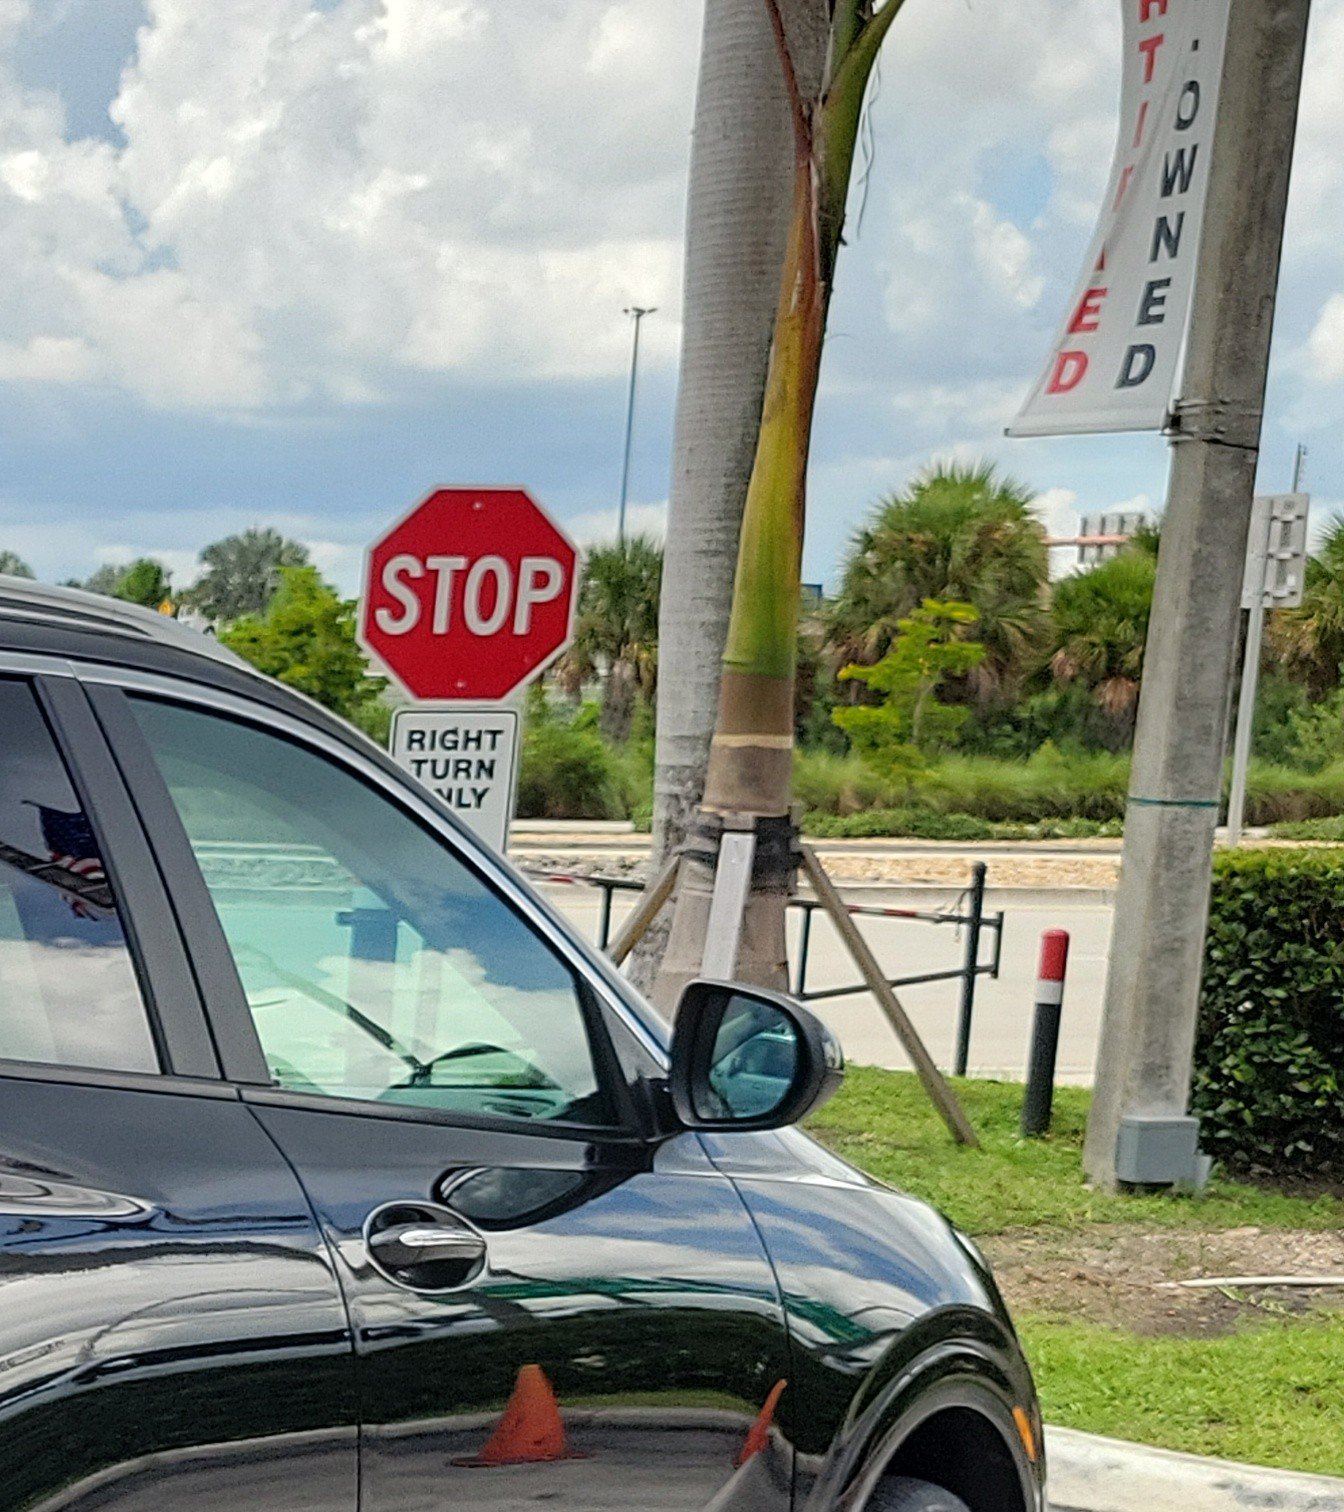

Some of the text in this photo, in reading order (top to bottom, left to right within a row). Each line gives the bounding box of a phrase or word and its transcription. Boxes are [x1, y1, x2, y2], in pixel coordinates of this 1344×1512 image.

[374, 553, 564, 637] STOP
[407, 728, 504, 751] RIGHT
[411, 759, 496, 780] TURN
[433, 787, 490, 809] NLY
